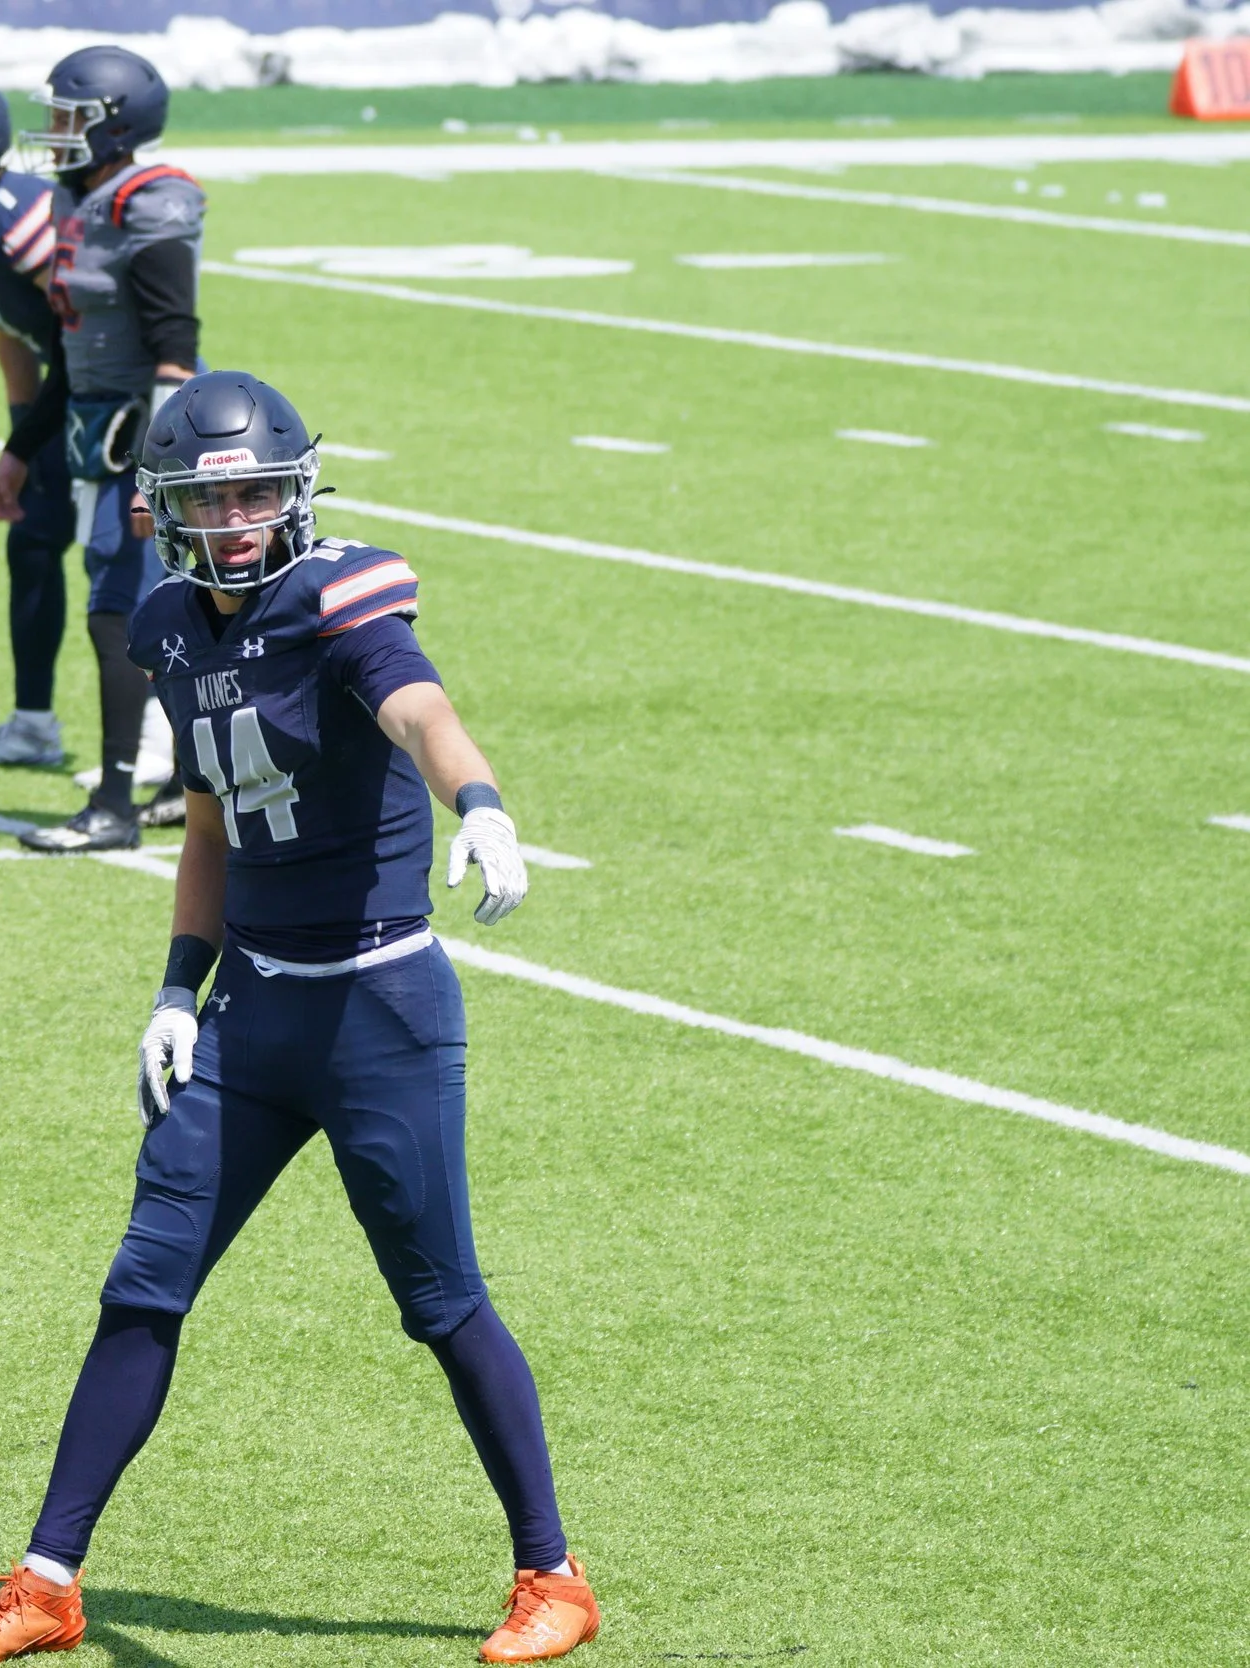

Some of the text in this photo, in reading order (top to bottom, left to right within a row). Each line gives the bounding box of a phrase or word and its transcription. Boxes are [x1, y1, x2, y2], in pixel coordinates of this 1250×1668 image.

[203, 452, 248, 467] Riddell
[194, 670, 243, 712] MINES
[193, 706, 300, 849] 14
